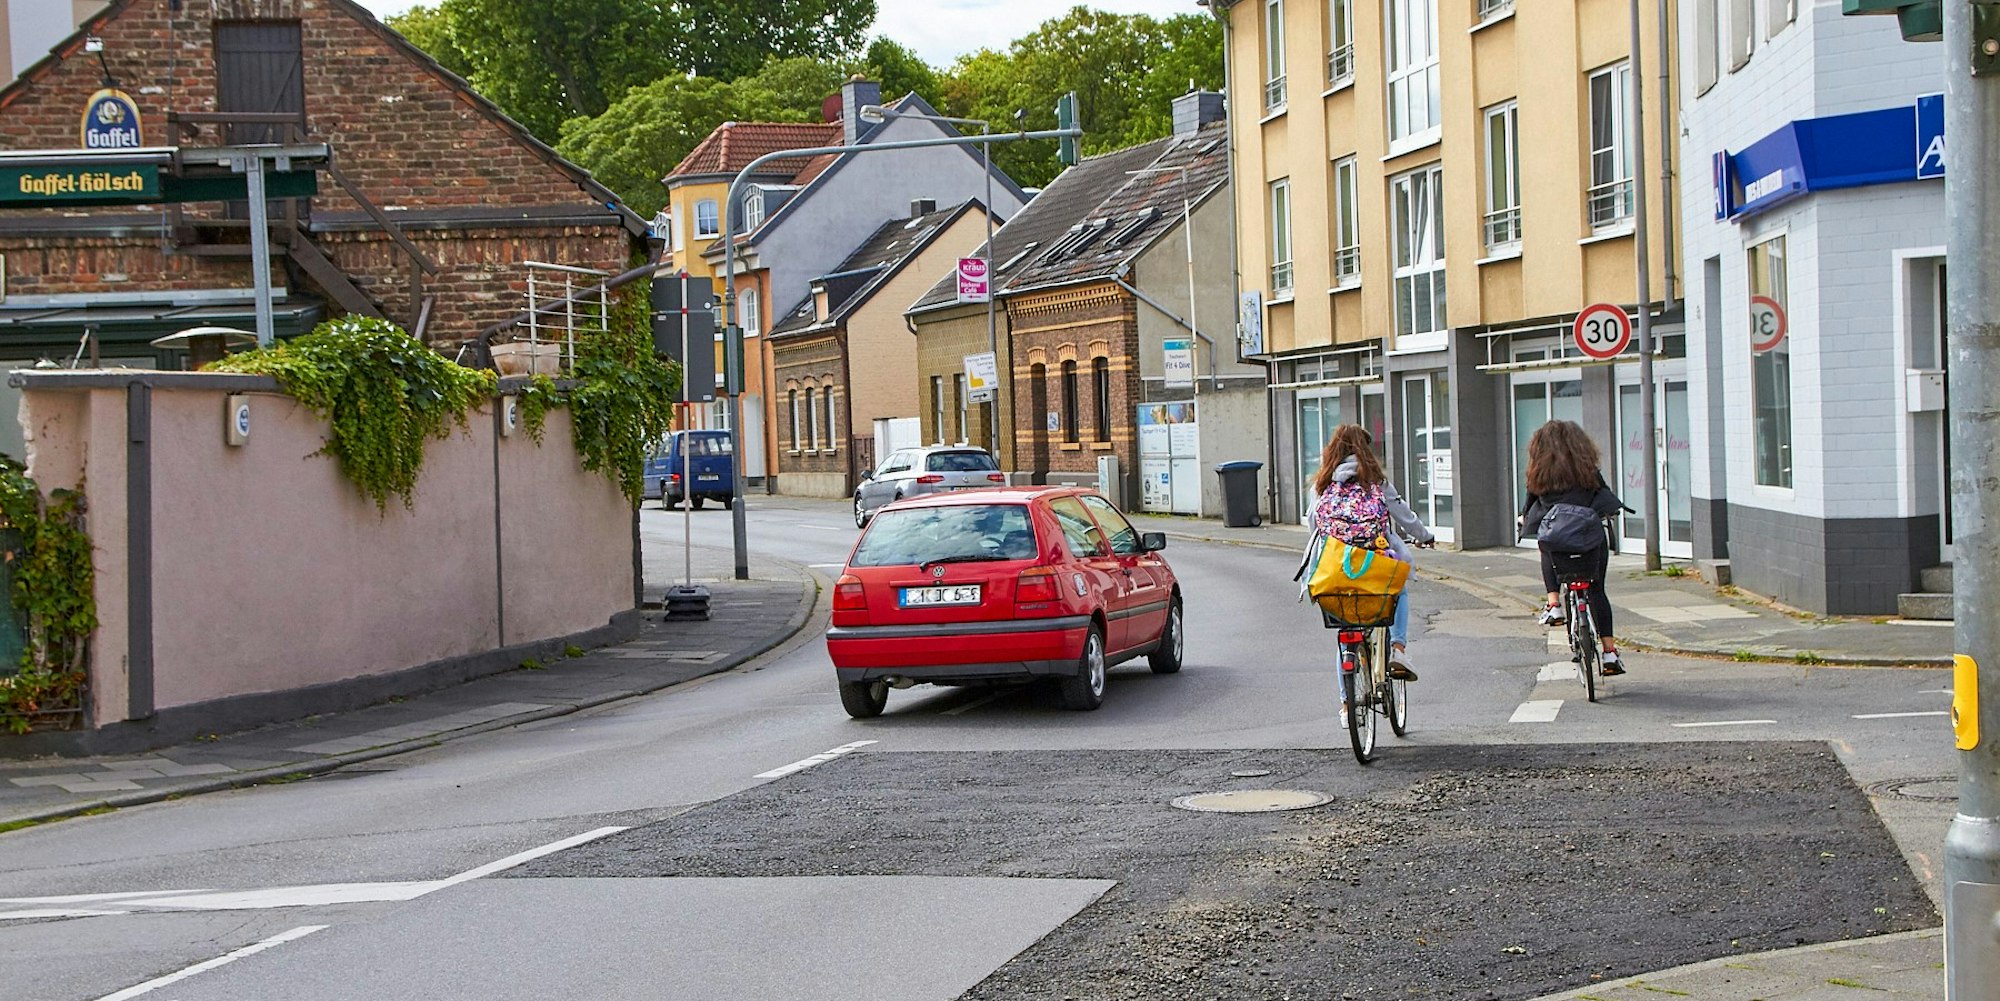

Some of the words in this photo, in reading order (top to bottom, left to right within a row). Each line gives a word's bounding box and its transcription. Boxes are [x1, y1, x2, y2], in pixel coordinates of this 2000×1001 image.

[87, 128, 138, 148] Gaffel
[20, 171, 143, 196] Gaffel-Kölsch
[1586, 318, 1618, 344] 30
